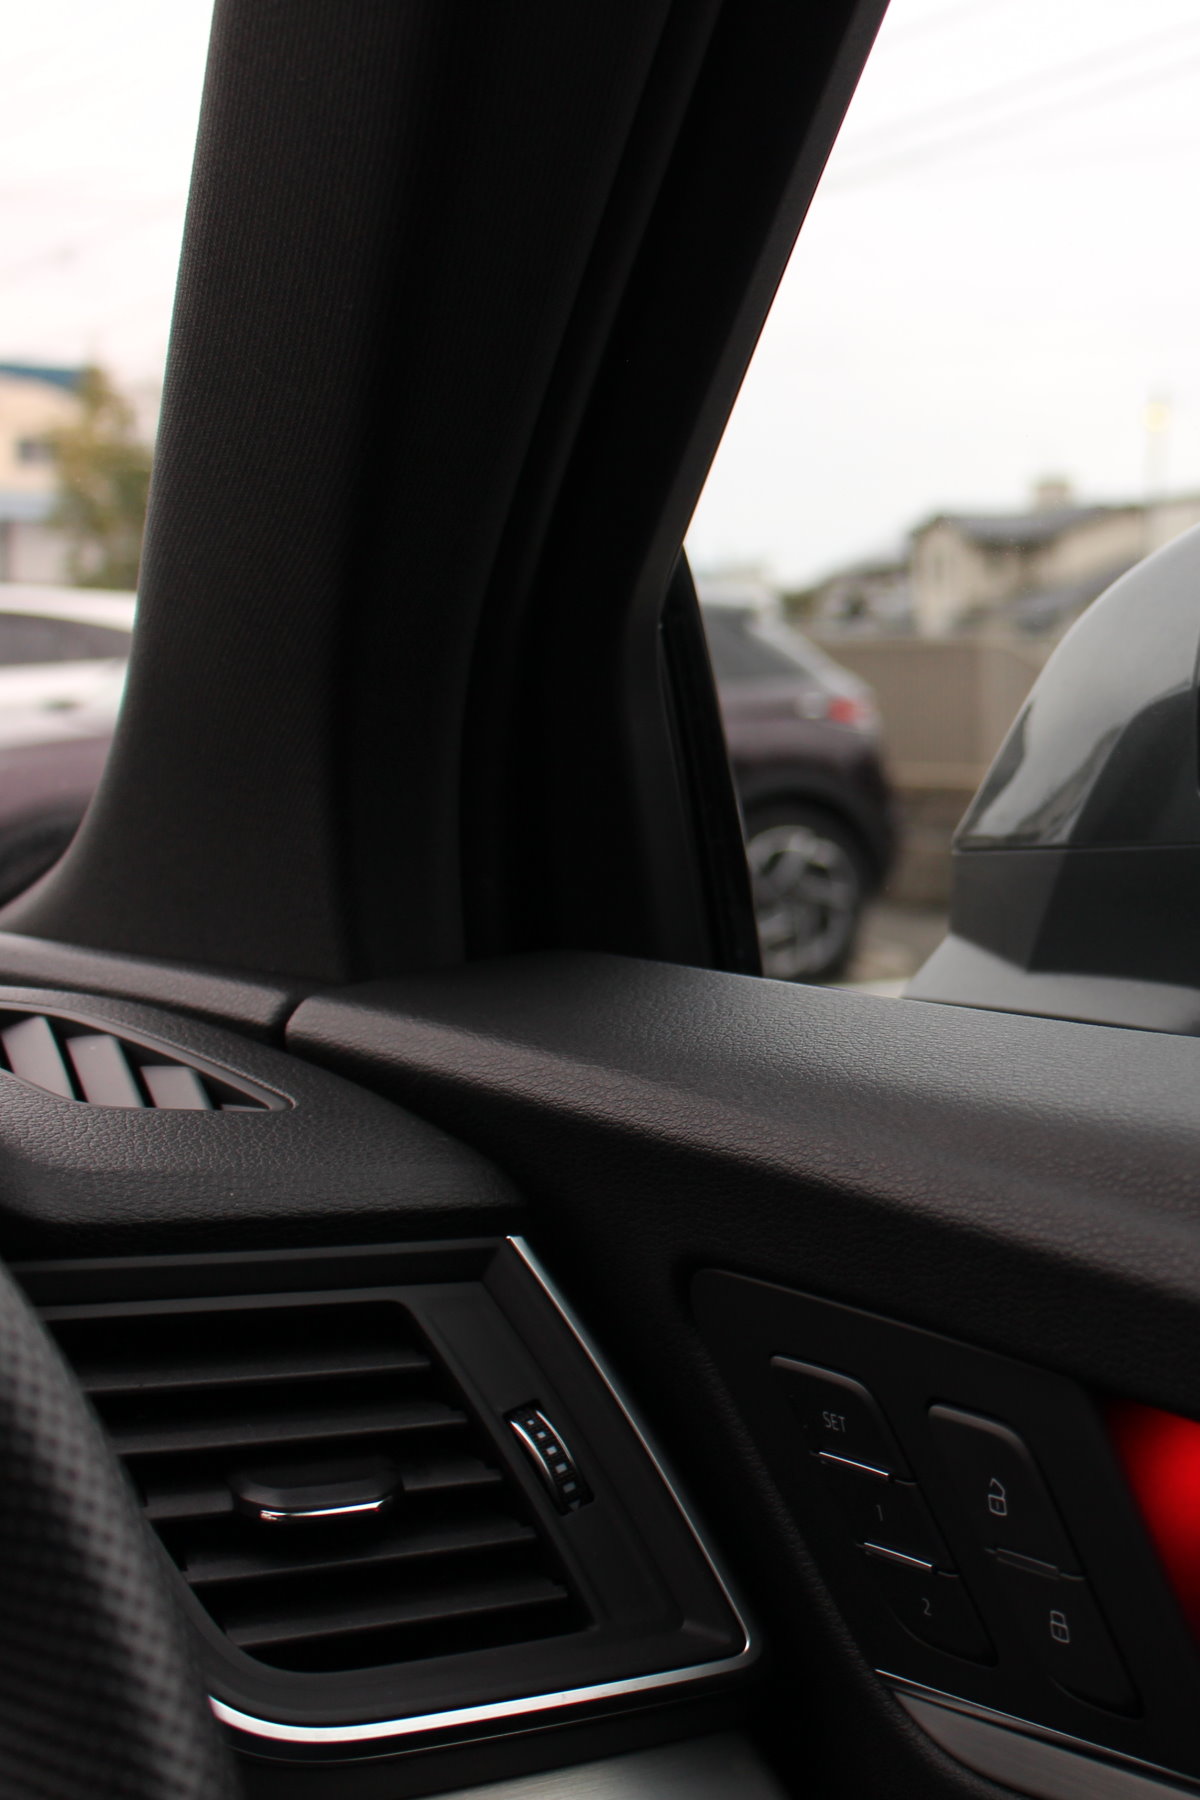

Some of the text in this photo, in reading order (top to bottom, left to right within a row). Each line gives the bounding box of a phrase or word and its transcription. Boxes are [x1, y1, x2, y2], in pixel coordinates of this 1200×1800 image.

[822, 1410, 847, 1433] SET
[875, 1504, 884, 1522] 1
[921, 1597, 933, 1616] 2
